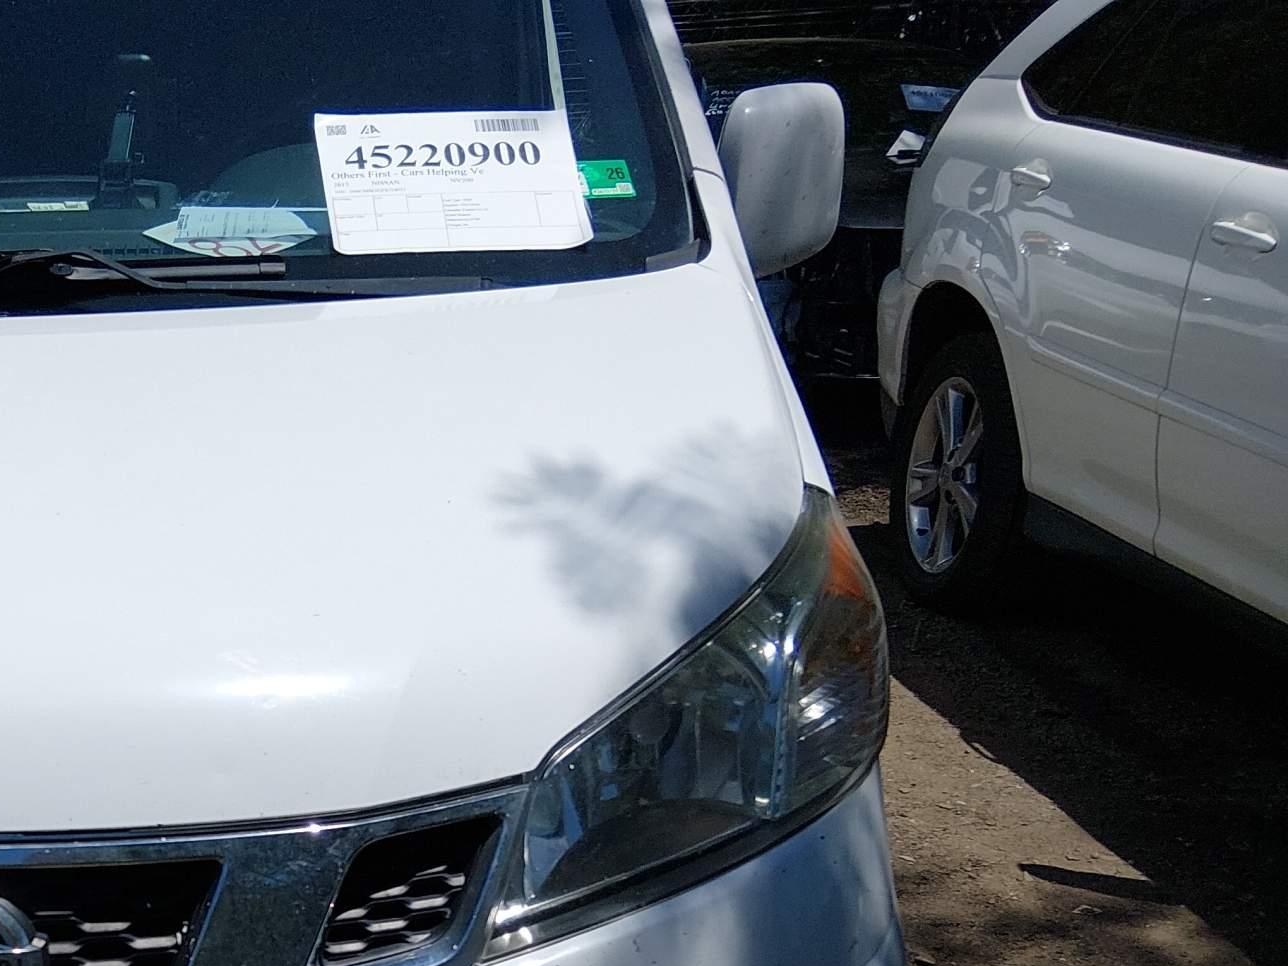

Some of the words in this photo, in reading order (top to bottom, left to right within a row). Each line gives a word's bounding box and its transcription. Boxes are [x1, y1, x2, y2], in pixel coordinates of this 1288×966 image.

[345, 140, 541, 170] 45220900
[331, 172, 365, 180] Others
[368, 170, 391, 178] First
[401, 168, 424, 177] Cars
[427, 168, 467, 177] Helping
[606, 167, 626, 180] 26
